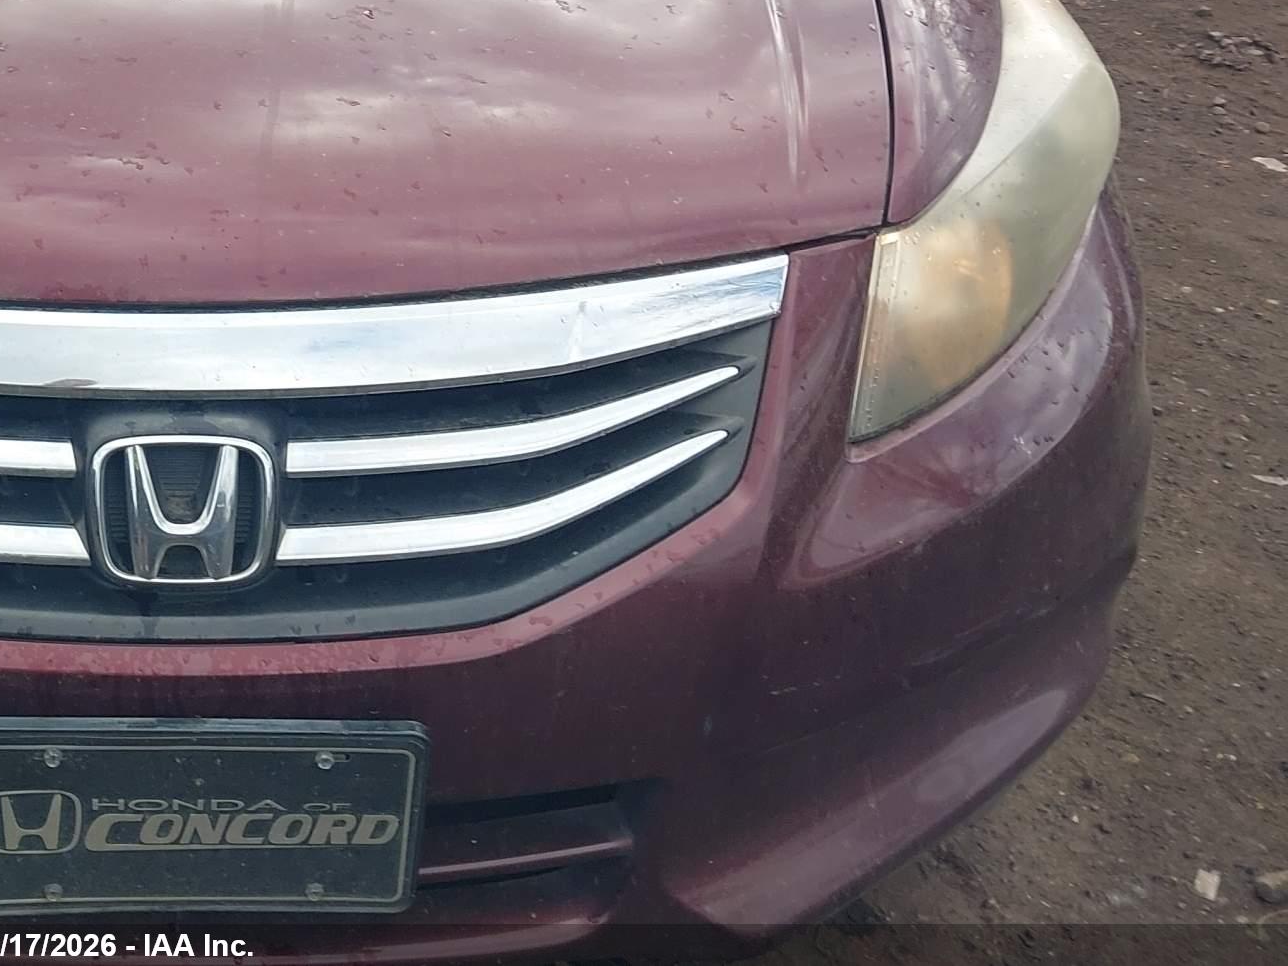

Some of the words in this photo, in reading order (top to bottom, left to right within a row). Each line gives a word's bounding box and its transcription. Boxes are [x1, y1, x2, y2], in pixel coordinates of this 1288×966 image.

[91, 798, 288, 812] HONDA
[302, 802, 353, 812] OF
[84, 813, 400, 852] CONCORD
